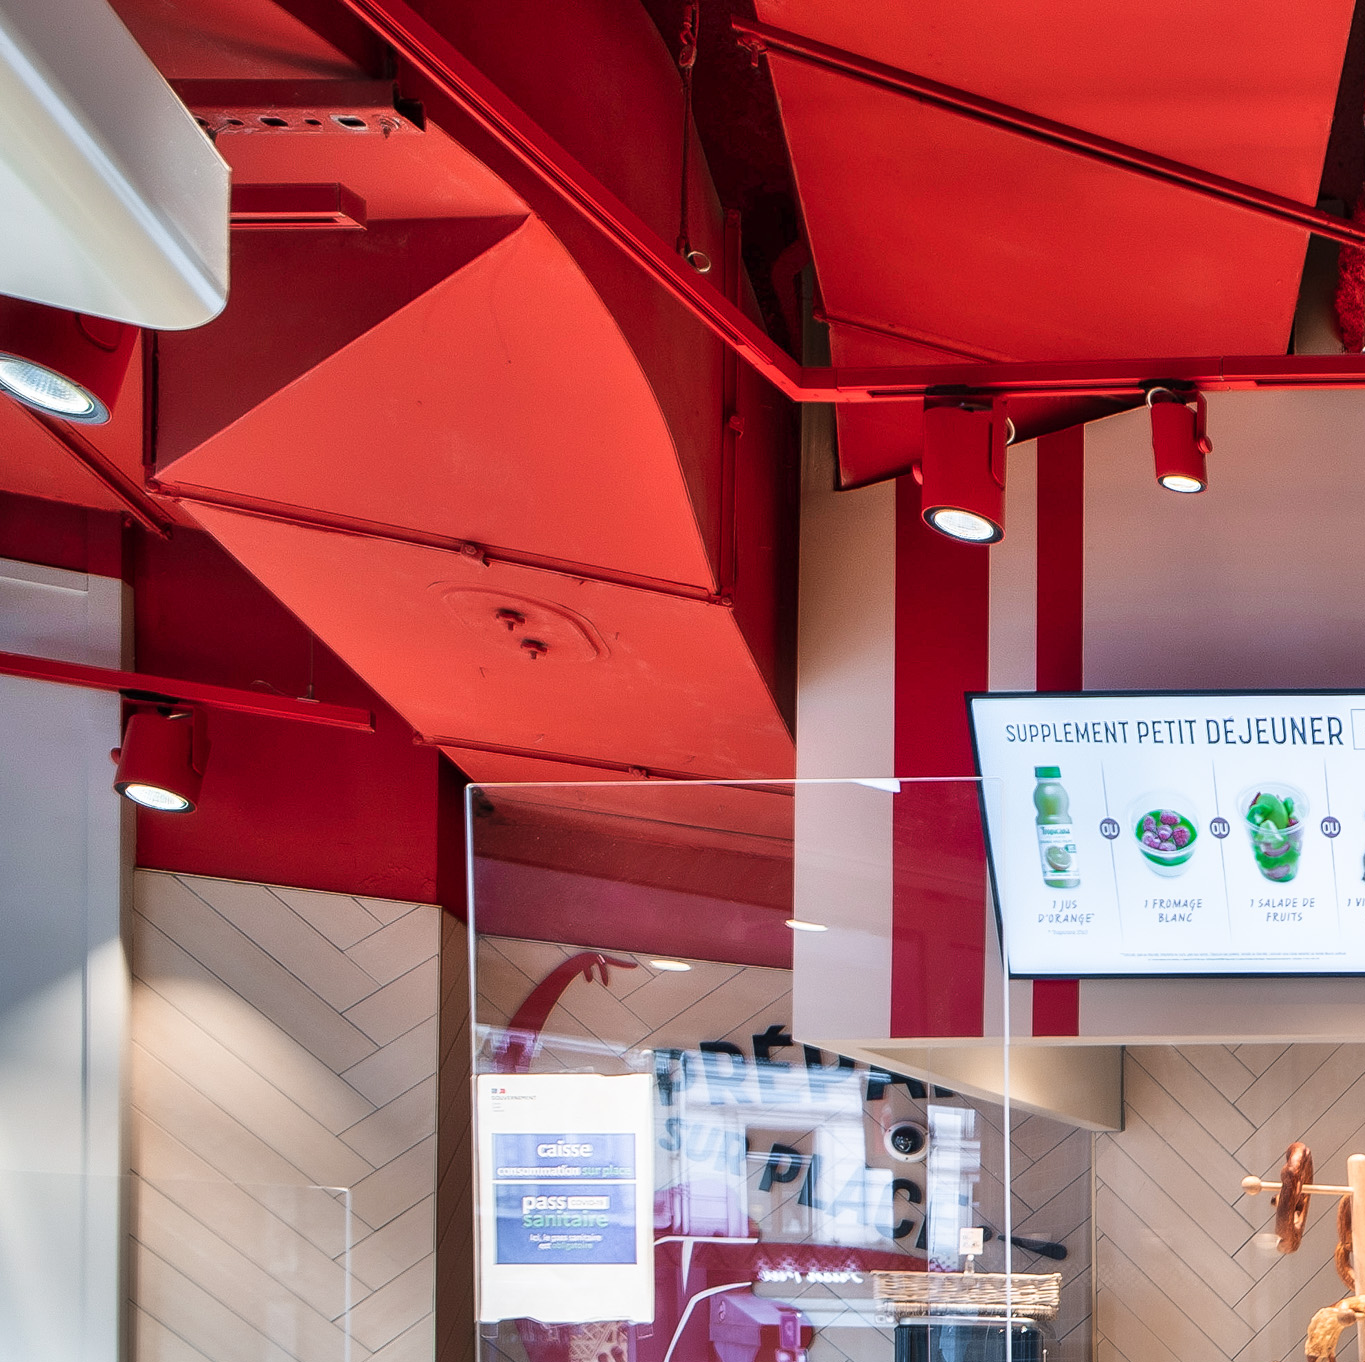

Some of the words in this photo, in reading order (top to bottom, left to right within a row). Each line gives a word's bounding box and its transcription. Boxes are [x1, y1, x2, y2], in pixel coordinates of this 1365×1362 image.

[1137, 718, 1196, 744] PETIT
[1207, 714, 1344, 746] DÉJEUNER
[1101, 821, 1120, 836] OU
[1211, 821, 1230, 836] OU
[1322, 820, 1340, 836] OU
[1052, 900, 1056, 908] 1
[1060, 900, 1078, 912] JUS
[1144, 900, 1148, 908] 1
[1152, 899, 1202, 911] FROMAGE
[1250, 898, 1254, 908] 1
[1258, 898, 1299, 908] SALADE
[1303, 898, 1315, 908] DE
[1347, 898, 1352, 907] 1
[1159, 913, 1192, 922] BLANC
[1266, 912, 1302, 922] FRUITS
[537, 1140, 593, 1157] caisse
[497, 1165, 580, 1176] consommation
[582, 1166, 600, 1176] sur
[522, 1196, 567, 1214] pass
[522, 1211, 609, 1228] sanitaire
